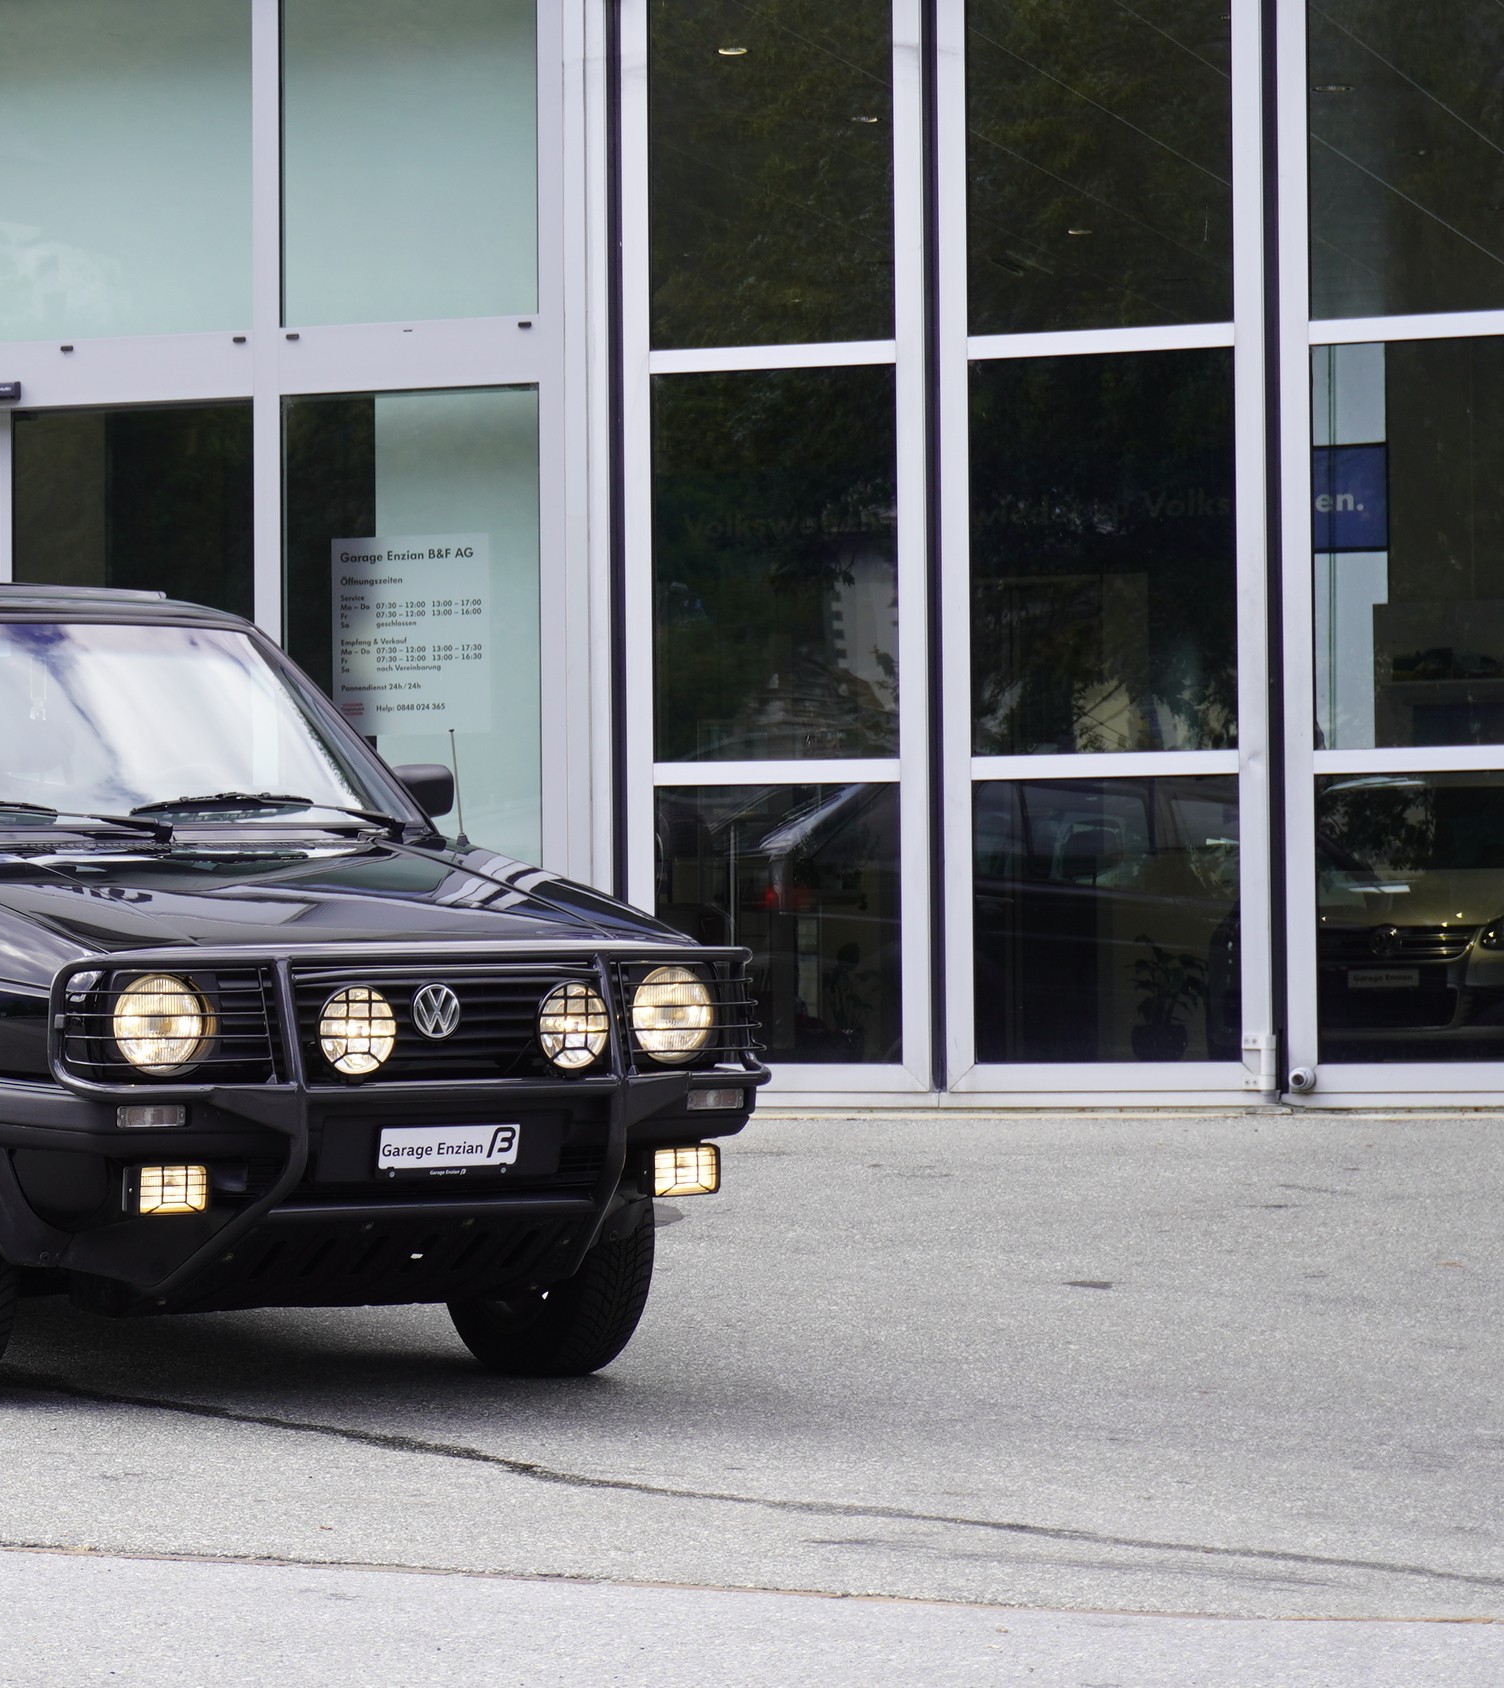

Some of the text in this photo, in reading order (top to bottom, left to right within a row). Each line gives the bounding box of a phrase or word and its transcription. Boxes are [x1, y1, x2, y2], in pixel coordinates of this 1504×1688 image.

[340, 547, 474, 564] Garage Enzian B&F AG
[340, 576, 403, 587] Öffnungszeiten
[340, 594, 365, 602] Service
[376, 602, 396, 610] 07:30
[405, 601, 426, 609] 12:00
[432, 600, 453, 608] 13:00
[461, 599, 482, 607] 17:00
[376, 611, 396, 619] 07:30
[405, 610, 426, 618] 12:00
[432, 609, 453, 617] 13:00
[461, 608, 482, 616] 16:00
[376, 619, 417, 628] geschlossen
[341, 639, 372, 647] Empfang
[380, 637, 407, 645] Verkauf
[376, 646, 397, 655] 07:30
[406, 646, 427, 654] 12:00
[432, 645, 453, 653] 13:00
[461, 644, 482, 652] 17:30
[376, 655, 397, 664] 07:30
[406, 654, 427, 662] 12:00
[432, 654, 453, 662] 13:00
[461, 653, 482, 661] 16:30
[376, 664, 394, 672] nach
[395, 663, 442, 672] Vereinbarung
[341, 684, 387, 692] Pannendienst
[376, 702, 446, 713] Help: 0848 024 365
[414, 984, 460, 1039] VW
[382, 1144, 433, 1159] Garage
[437, 1141, 484, 1155] Enzian
